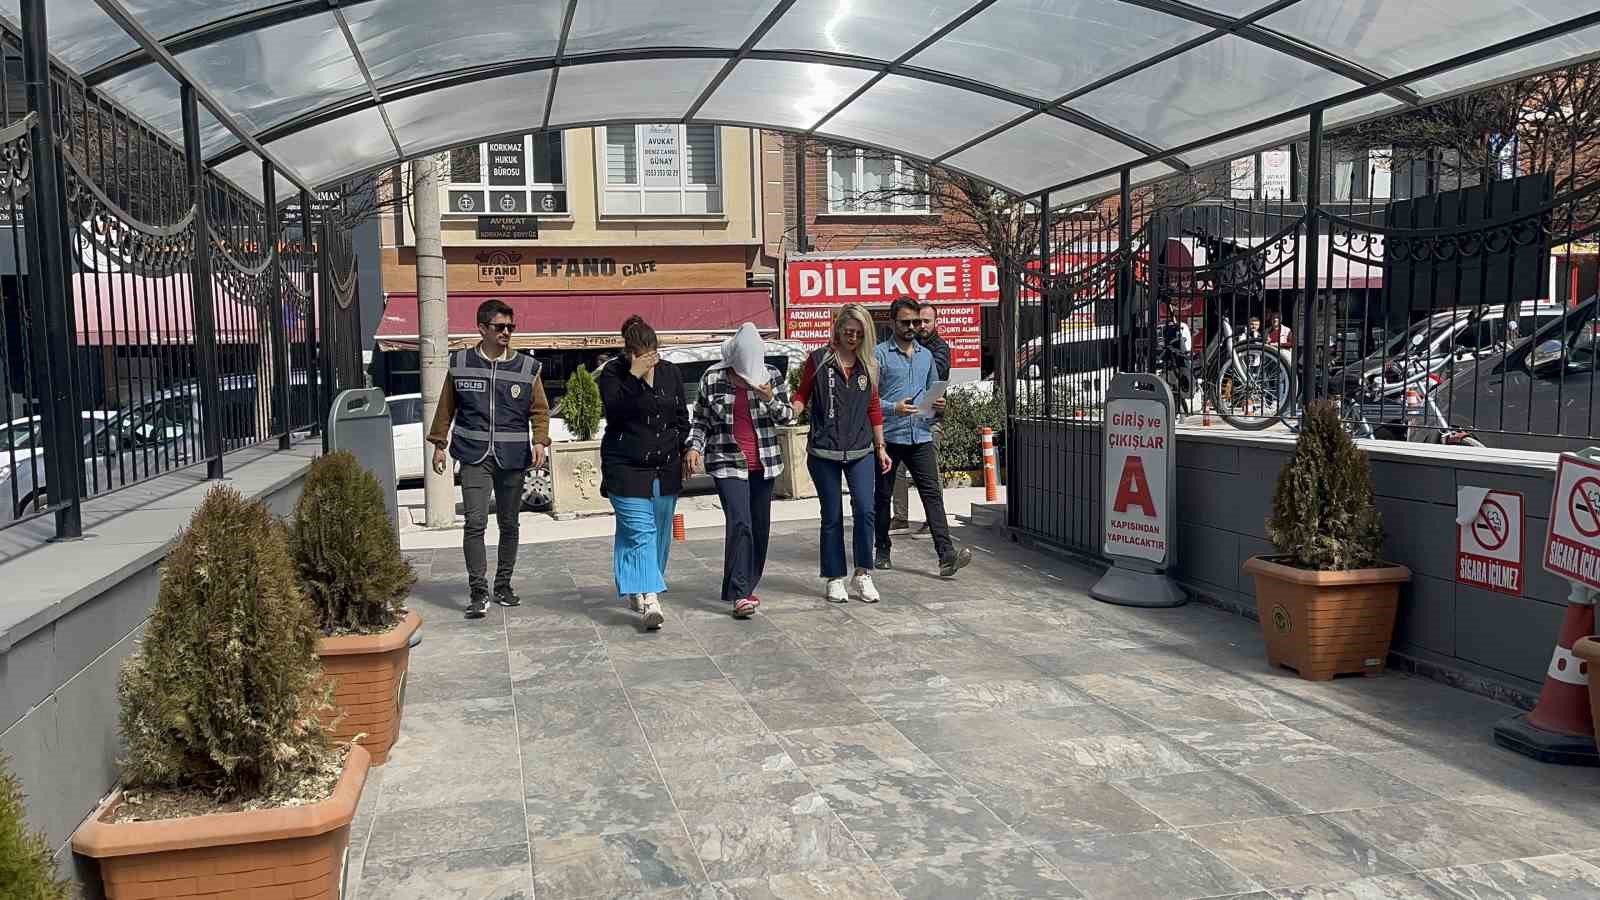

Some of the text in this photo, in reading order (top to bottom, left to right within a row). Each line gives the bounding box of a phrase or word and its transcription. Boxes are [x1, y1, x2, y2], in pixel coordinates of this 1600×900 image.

[490, 143, 523, 152] KORKMAZ
[495, 155, 518, 164] HUKUK
[493, 166, 520, 177] BÜROSU
[490, 217, 526, 225] AVUKAT
[481, 267, 517, 276] EFANO
[536, 258, 657, 277] EFANO CAFE
[799, 263, 956, 300] DİLEKÇE
[790, 310, 831, 320] ARZUHALCİ
[790, 328, 832, 339] ARZUHALCİ
[1112, 411, 1161, 430] GİRİŞ ve
[1109, 433, 1165, 450] ÇIKIŞLAR
[1113, 455, 1157, 518] A
[1111, 520, 1160, 534] KAPISINDAN
[1107, 532, 1165, 550] YAPILACAKTIR
[1549, 537, 1578, 574] SİGARA
[1460, 554, 1519, 591] SİGARA İÇİLMEZ
